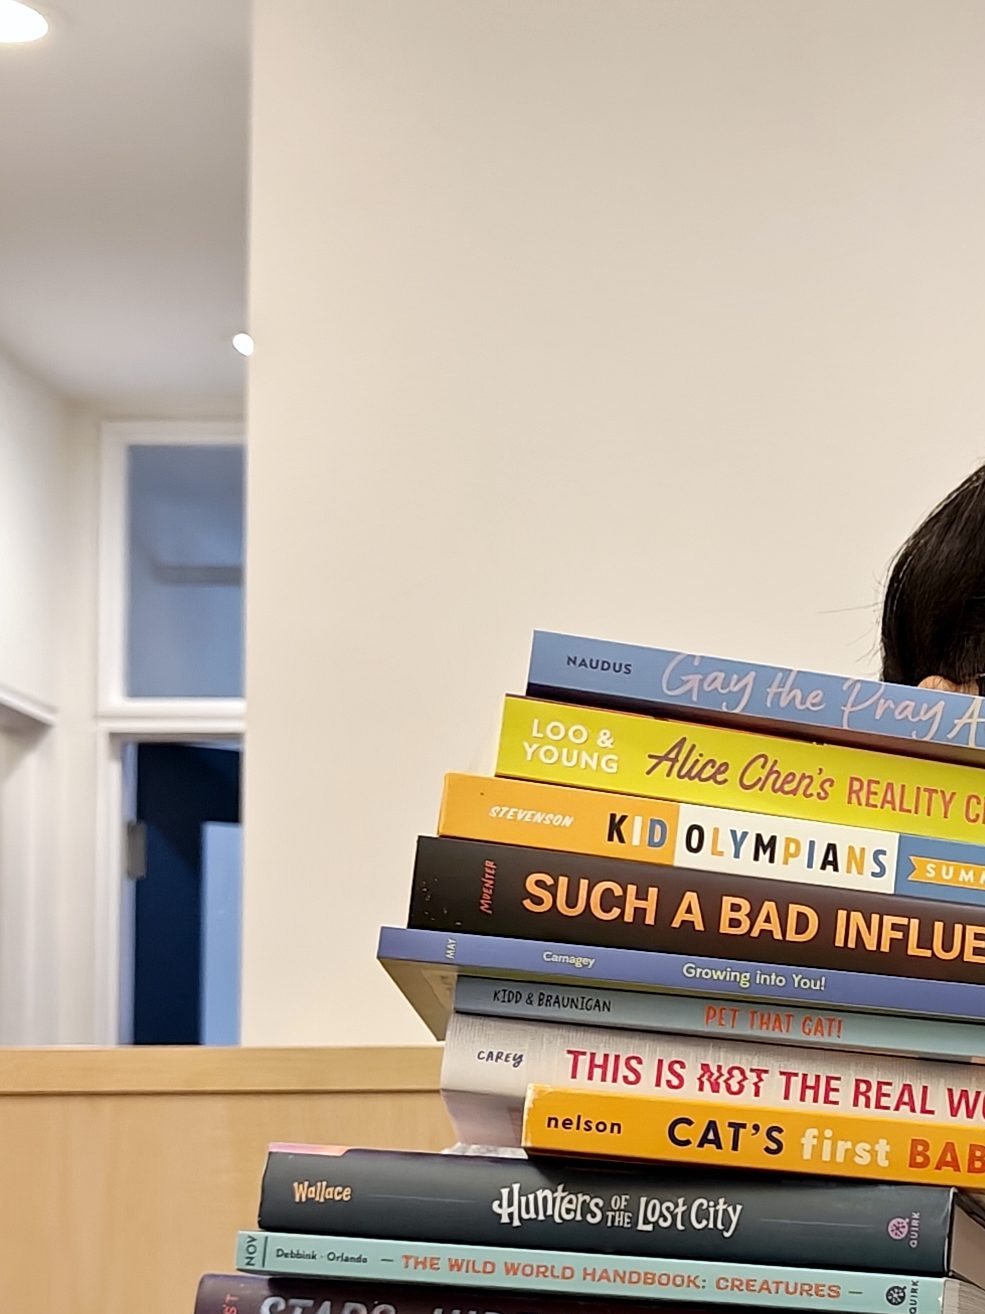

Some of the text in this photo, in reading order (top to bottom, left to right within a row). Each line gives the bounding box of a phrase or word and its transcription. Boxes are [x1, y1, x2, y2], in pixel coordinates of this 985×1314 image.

[566, 655, 632, 675] NAUDUS
[661, 654, 754, 713] Gay
[767, 668, 825, 712] the
[842, 679, 942, 740] Pray
[532, 718, 614, 748] LOO &
[523, 742, 618, 773] YOUNG
[646, 737, 728, 785] Alice
[738, 753, 835, 800] Chen's
[847, 776, 957, 819] REALITY
[488, 805, 574, 829] STEVENSON
[607, 813, 887, 878] KID OLYMPIANS
[479, 858, 497, 915] MUENTER
[522, 872, 658, 926] SUCH
[671, 891, 705, 931] A
[718, 896, 819, 942] BAD
[445, 938, 456, 959] MAY
[543, 951, 596, 969] Carnagey
[682, 963, 826, 991] Growing into You!
[492, 988, 612, 1013] KIDD & BRAUNIGAN
[704, 1006, 844, 1039] PET THAT CAT!
[477, 1050, 524, 1068] CAREY
[566, 1048, 643, 1086] THIS
[655, 1058, 686, 1090] IS
[697, 1063, 770, 1100] NOT
[779, 1071, 842, 1106] THE
[853, 1077, 936, 1117] REAL
[546, 1113, 622, 1135] nelson
[667, 1117, 785, 1156] CAT'S
[801, 1128, 891, 1168] first
[293, 1181, 352, 1202] Wallace
[492, 1182, 743, 1238] Hunters OF THE Lost City
[910, 1211, 921, 1248] QUIRK
[244, 1235, 257, 1267] NOV
[275, 1247, 368, 1264] Debbink Orlando
[401, 1254, 842, 1299] THE WILD WORLD HANDBOOK: CREATURES
[908, 1280, 919, 1314] QUIRK
